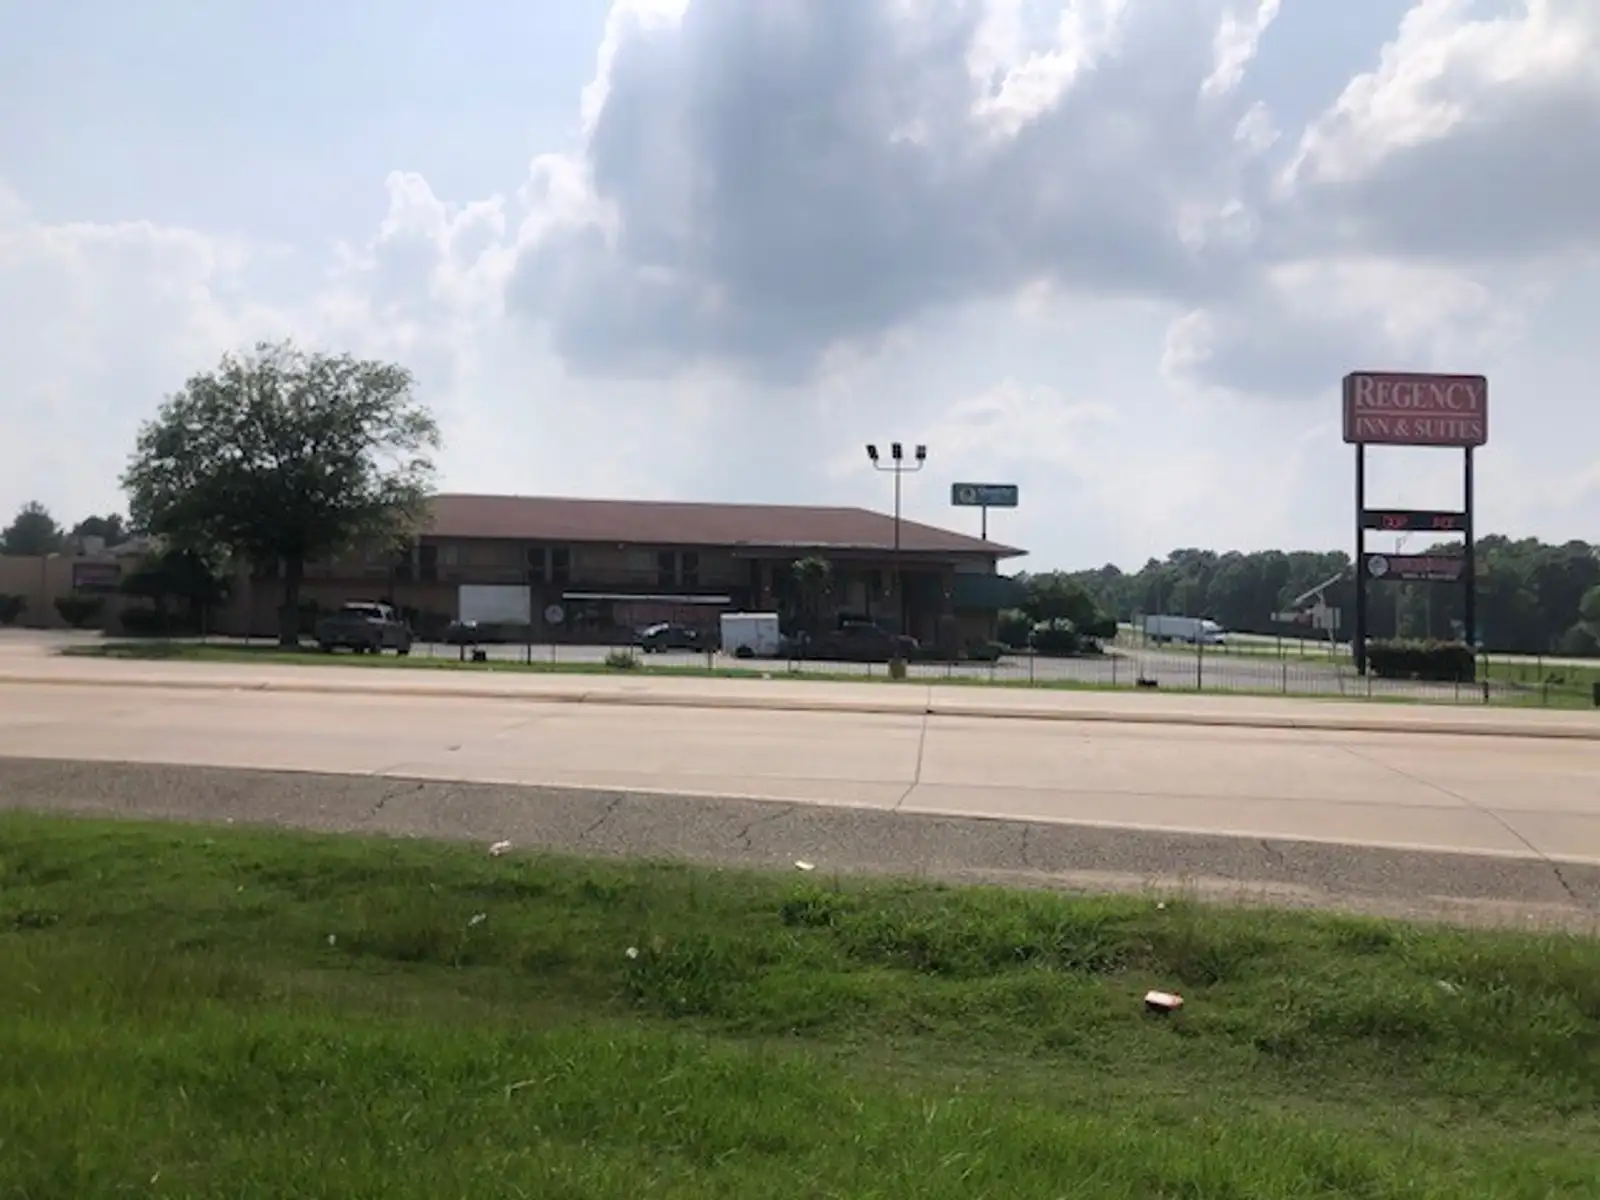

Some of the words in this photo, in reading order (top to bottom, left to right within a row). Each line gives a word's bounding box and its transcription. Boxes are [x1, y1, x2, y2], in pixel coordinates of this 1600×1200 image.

[1355, 376, 1481, 409] REGENCY
[1356, 418, 1391, 437] INN
[1394, 419, 1410, 437] &
[1414, 419, 1482, 438] SUITES
